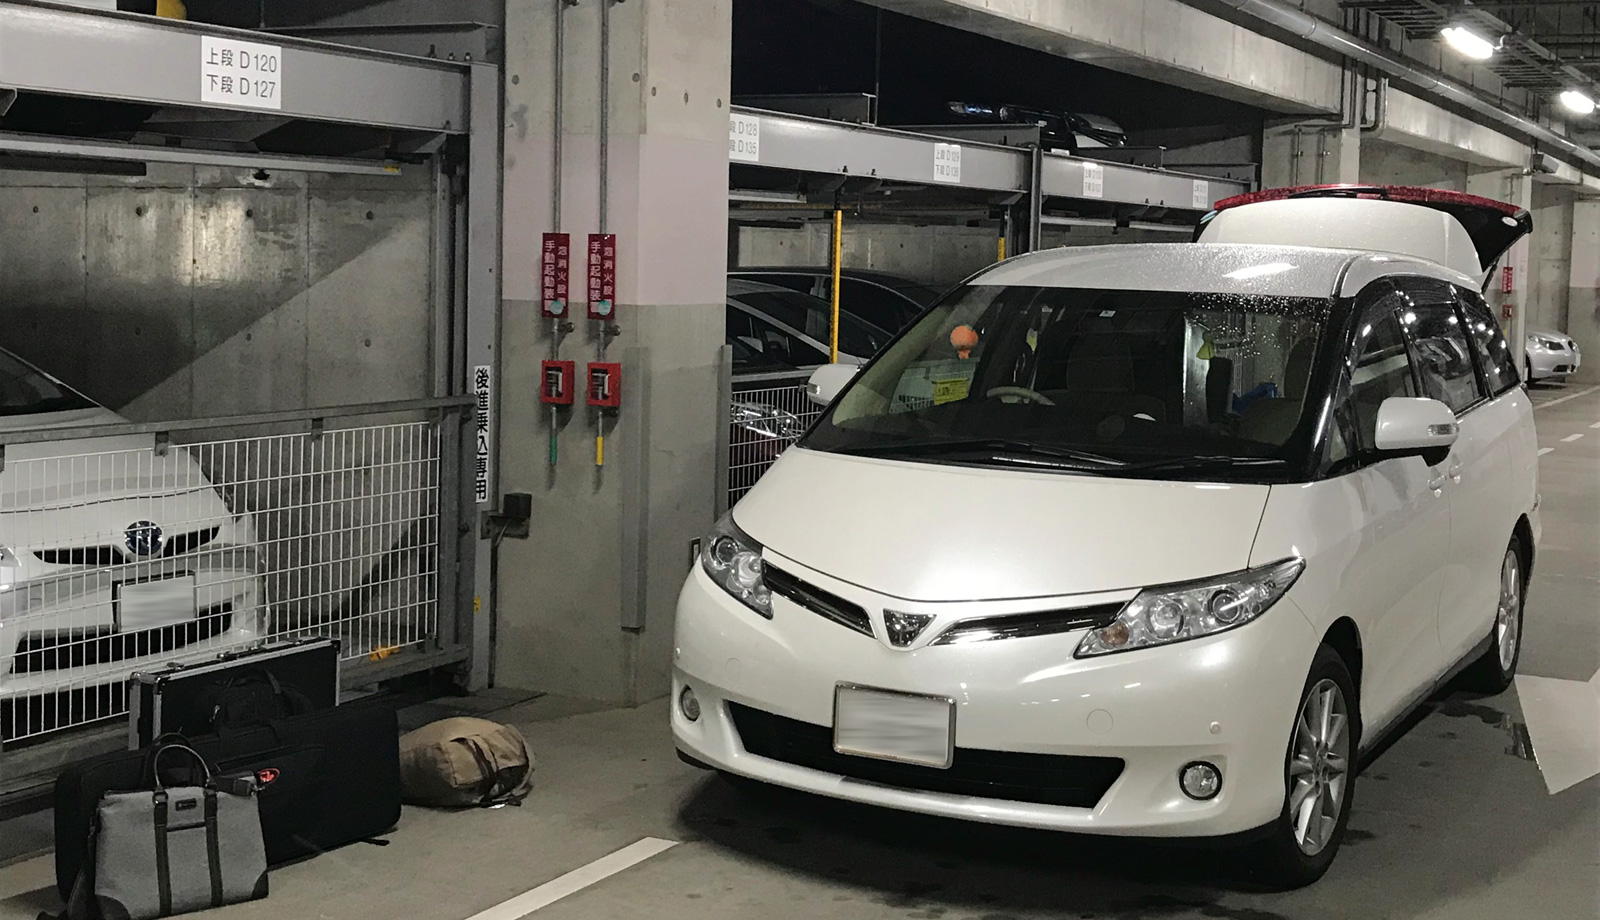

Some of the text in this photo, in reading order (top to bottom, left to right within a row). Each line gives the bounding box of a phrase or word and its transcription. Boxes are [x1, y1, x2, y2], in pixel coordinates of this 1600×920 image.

[206, 47, 233, 67] 上段
[206, 73, 233, 94] 下段
[603, 247, 614, 308] 泡消火設
[476, 367, 490, 500] 後進乗入専用
